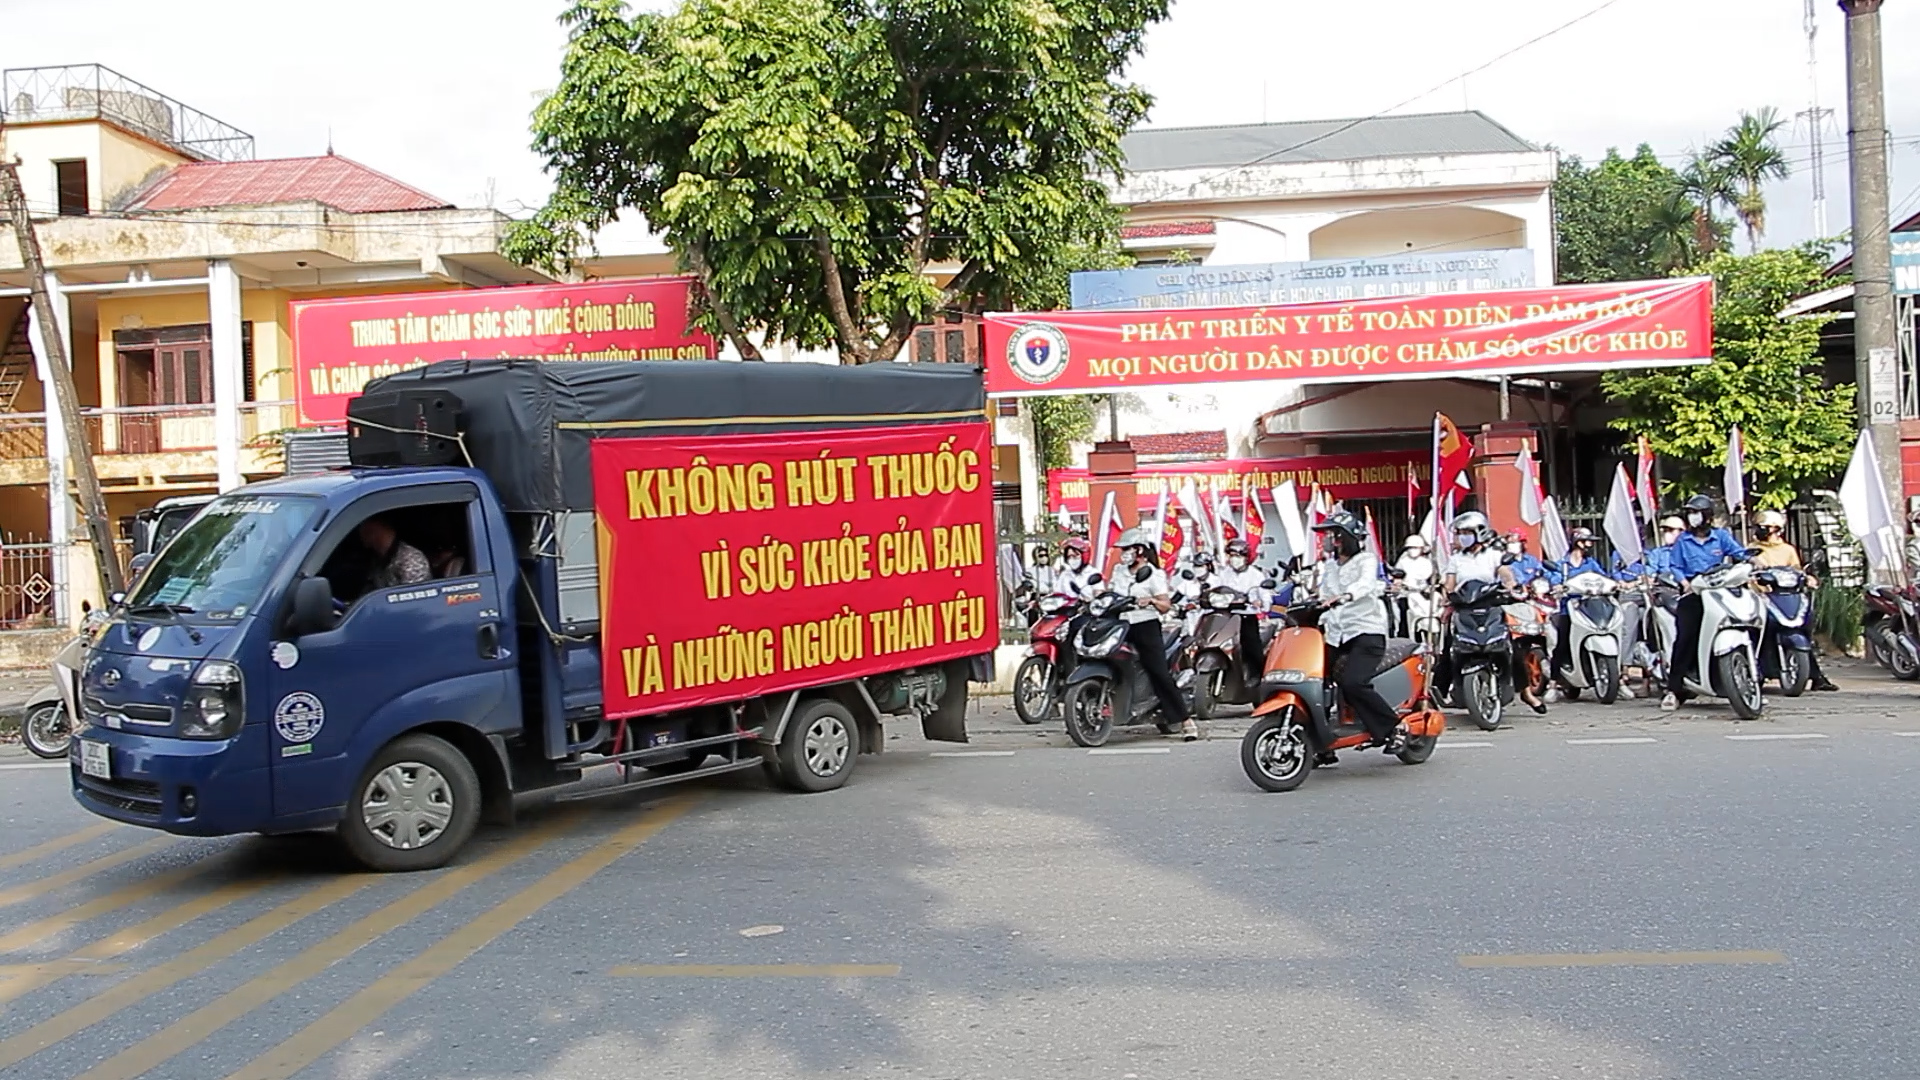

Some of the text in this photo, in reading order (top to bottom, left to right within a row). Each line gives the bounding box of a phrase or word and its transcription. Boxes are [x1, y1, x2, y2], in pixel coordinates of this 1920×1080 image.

[1350, 260, 1390, 278] TỈNH
[351, 293, 655, 348] TRUNG TÂM CHĂM SÓC SỨC KHOẺ CỘNG ĐỒNG
[1121, 316, 1195, 343] PHÁT
[1201, 307, 1286, 338] TRIỂN
[1293, 314, 1311, 335] Y
[1317, 305, 1354, 333] TẾ
[1360, 304, 1437, 331] TOÀN
[1088, 357, 1142, 381] MỌI
[1147, 346, 1239, 375] NGƯỜI
[1245, 344, 1304, 371] DÂN
[1310, 344, 1390, 370] ĐƯỢC
[1397, 337, 1476, 363] CHĂM
[1484, 333, 1540, 358] SÓC
[1608, 323, 1687, 352] KHỎE
[310, 362, 330, 395] VÀ
[331, 361, 370, 394] CHĂM
[1874, 401, 1894, 415] 02
[625, 435, 981, 521] KHÔNG HÚT THUỐC
[1317, 465, 1358, 486] NHỮNG
[1361, 462, 1397, 484] NGƯỜI
[702, 516, 983, 600] VÌ SỨC KHỎE CỦA BẠN
[621, 590, 986, 698] VÀ NHỮNG NGƯỜI THÂN YÊU
